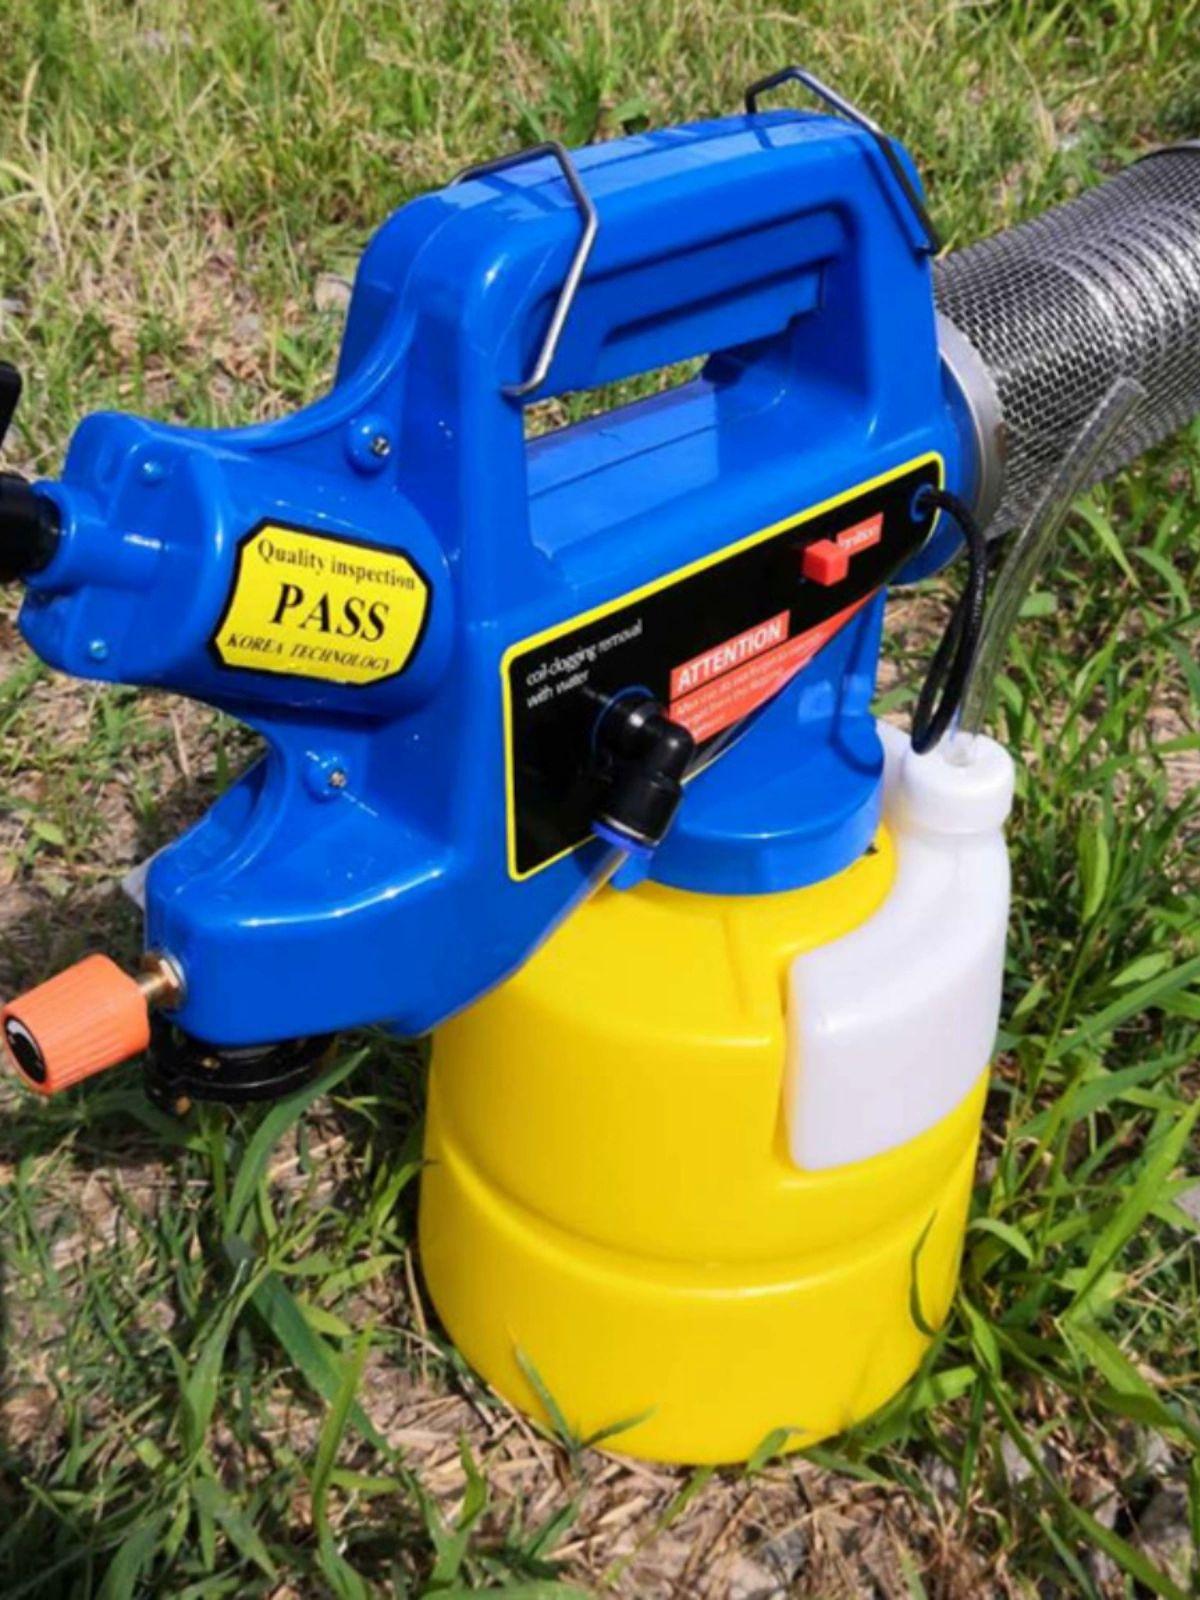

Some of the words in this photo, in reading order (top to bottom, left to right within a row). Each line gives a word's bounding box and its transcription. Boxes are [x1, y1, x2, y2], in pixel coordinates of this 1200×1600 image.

[257, 538, 325, 575] Quality
[331, 557, 415, 591] inspection
[270, 582, 389, 642] PASS
[598, 618, 643, 652] removal
[226, 633, 283, 654] KOREA
[290, 644, 391, 672] TECHNOLOGY
[677, 621, 781, 692] ATTENTION
[526, 685, 553, 709] with
[556, 669, 590, 694] water
